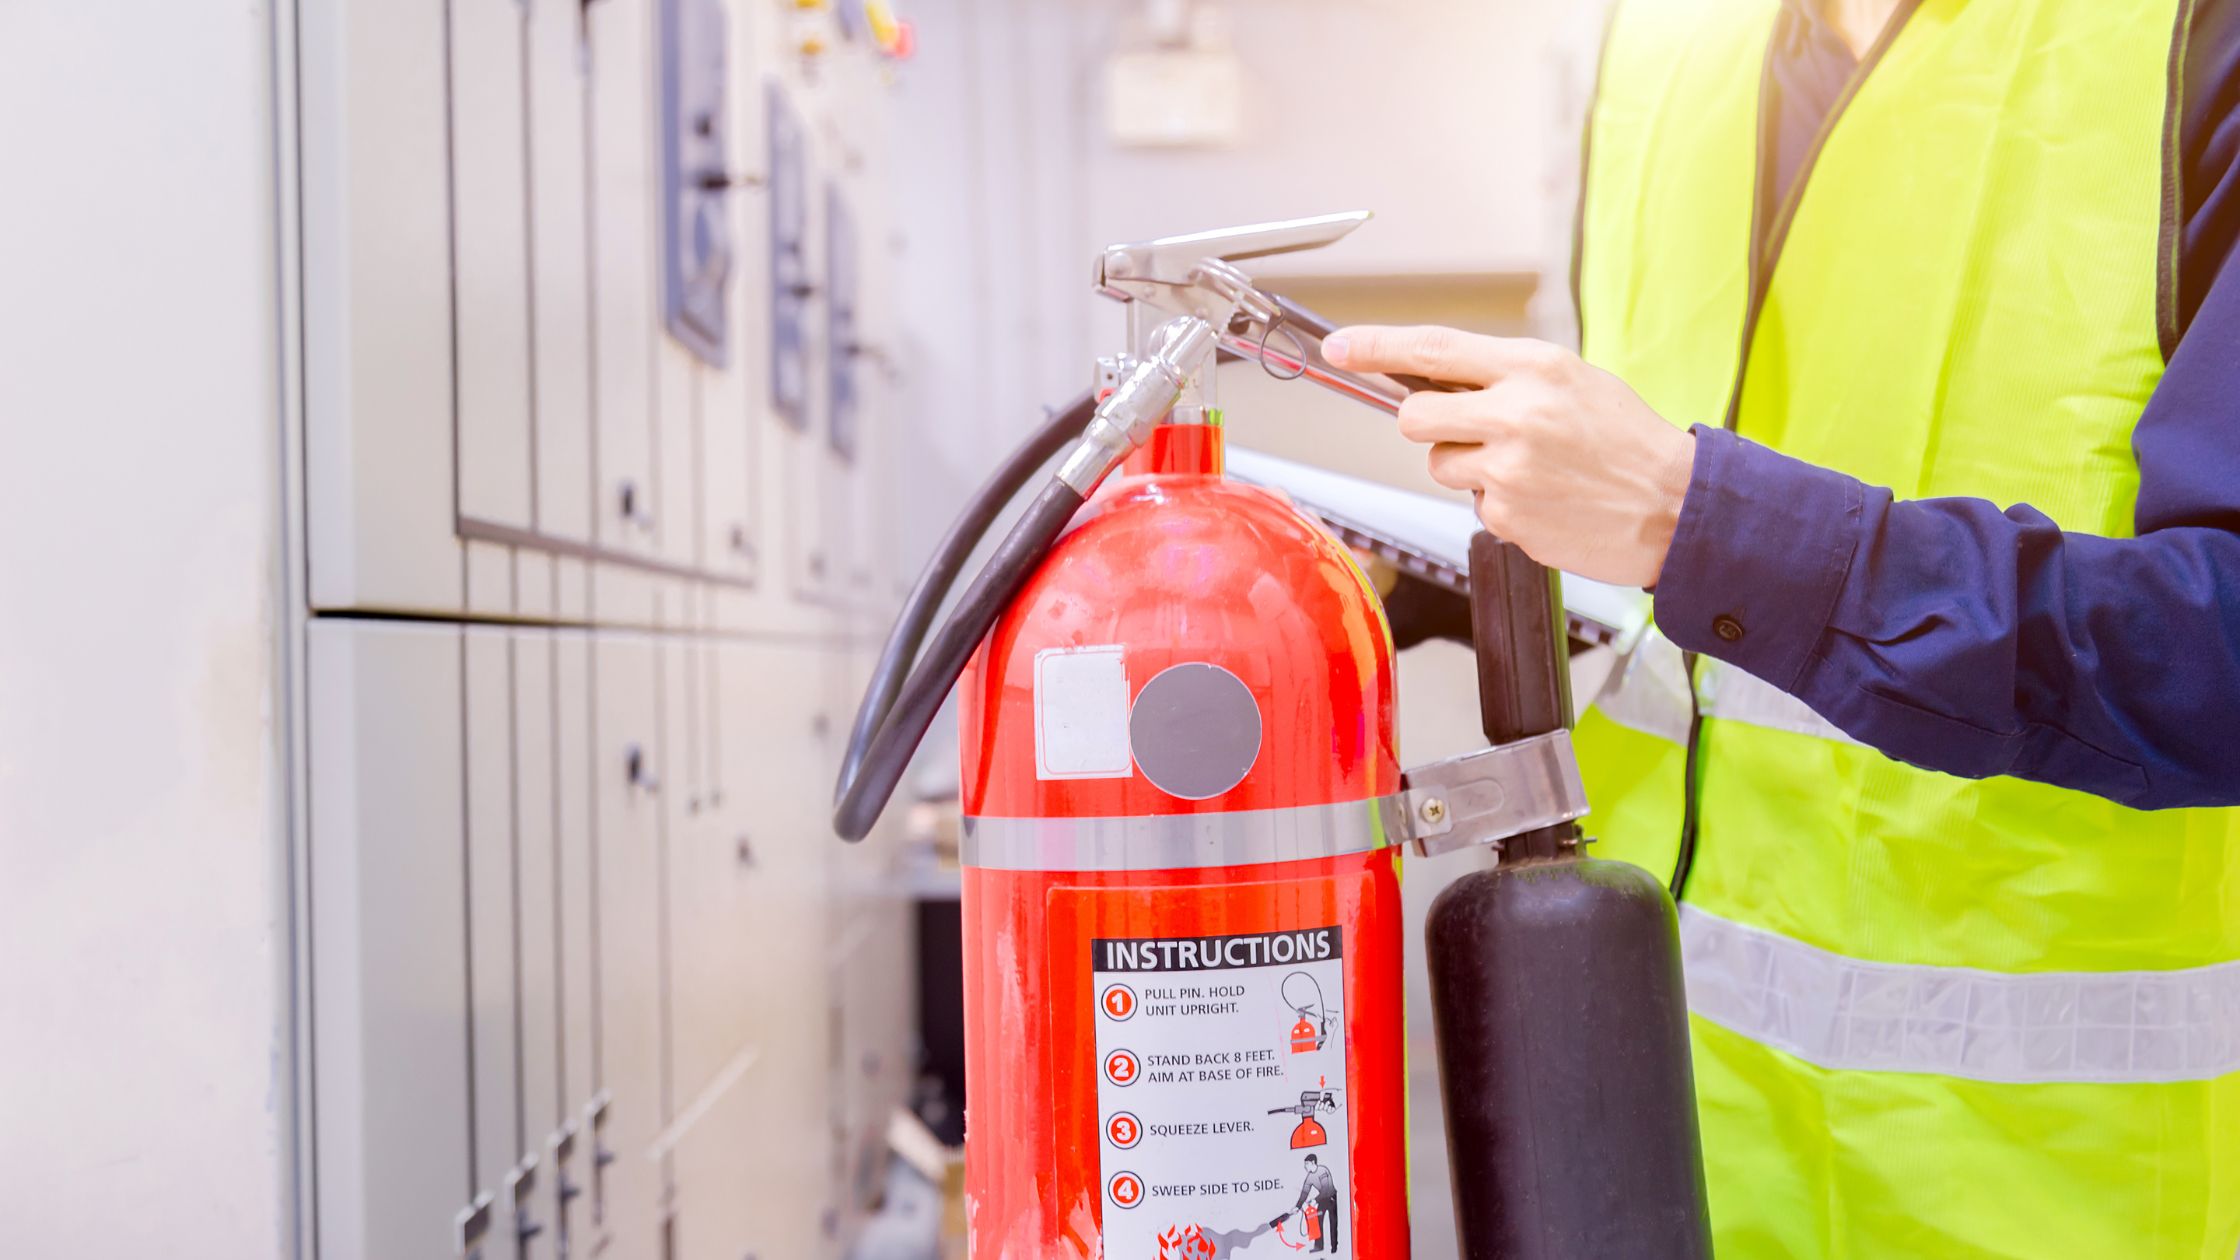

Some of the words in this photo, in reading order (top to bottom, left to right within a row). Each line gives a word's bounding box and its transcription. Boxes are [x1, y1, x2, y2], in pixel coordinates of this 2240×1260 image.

[1107, 930, 1331, 970] INSTRUCTIONS
[1145, 988, 1176, 1000] PULL
[1180, 987, 1205, 998] PIN.
[1209, 986, 1245, 997] HOLD
[1112, 993, 1124, 1012] 1
[1146, 1004, 1176, 1016] UNIT
[1181, 1002, 1239, 1015] UPRIGHT.
[1148, 1054, 1191, 1066] STAND
[1195, 1053, 1230, 1065] BACK
[1235, 1052, 1241, 1063] 8
[1246, 1050, 1275, 1062] FEET.
[1114, 1058, 1129, 1077] 2
[1148, 1071, 1174, 1083] AIM
[1178, 1070, 1195, 1081] AT
[1199, 1069, 1232, 1081] BASE
[1235, 1068, 1253, 1079] OF
[1256, 1065, 1284, 1078] FIRE.
[1116, 1121, 1131, 1140] 3
[1150, 1124, 1208, 1137] SQUEEZE
[1213, 1121, 1254, 1134] LEVER.
[1117, 1180, 1133, 1199] 4
[1152, 1185, 1196, 1197] SWEEP
[1200, 1183, 1228, 1195] SIDE
[1232, 1182, 1250, 1193] TO
[1254, 1179, 1284, 1192] SIDE.
